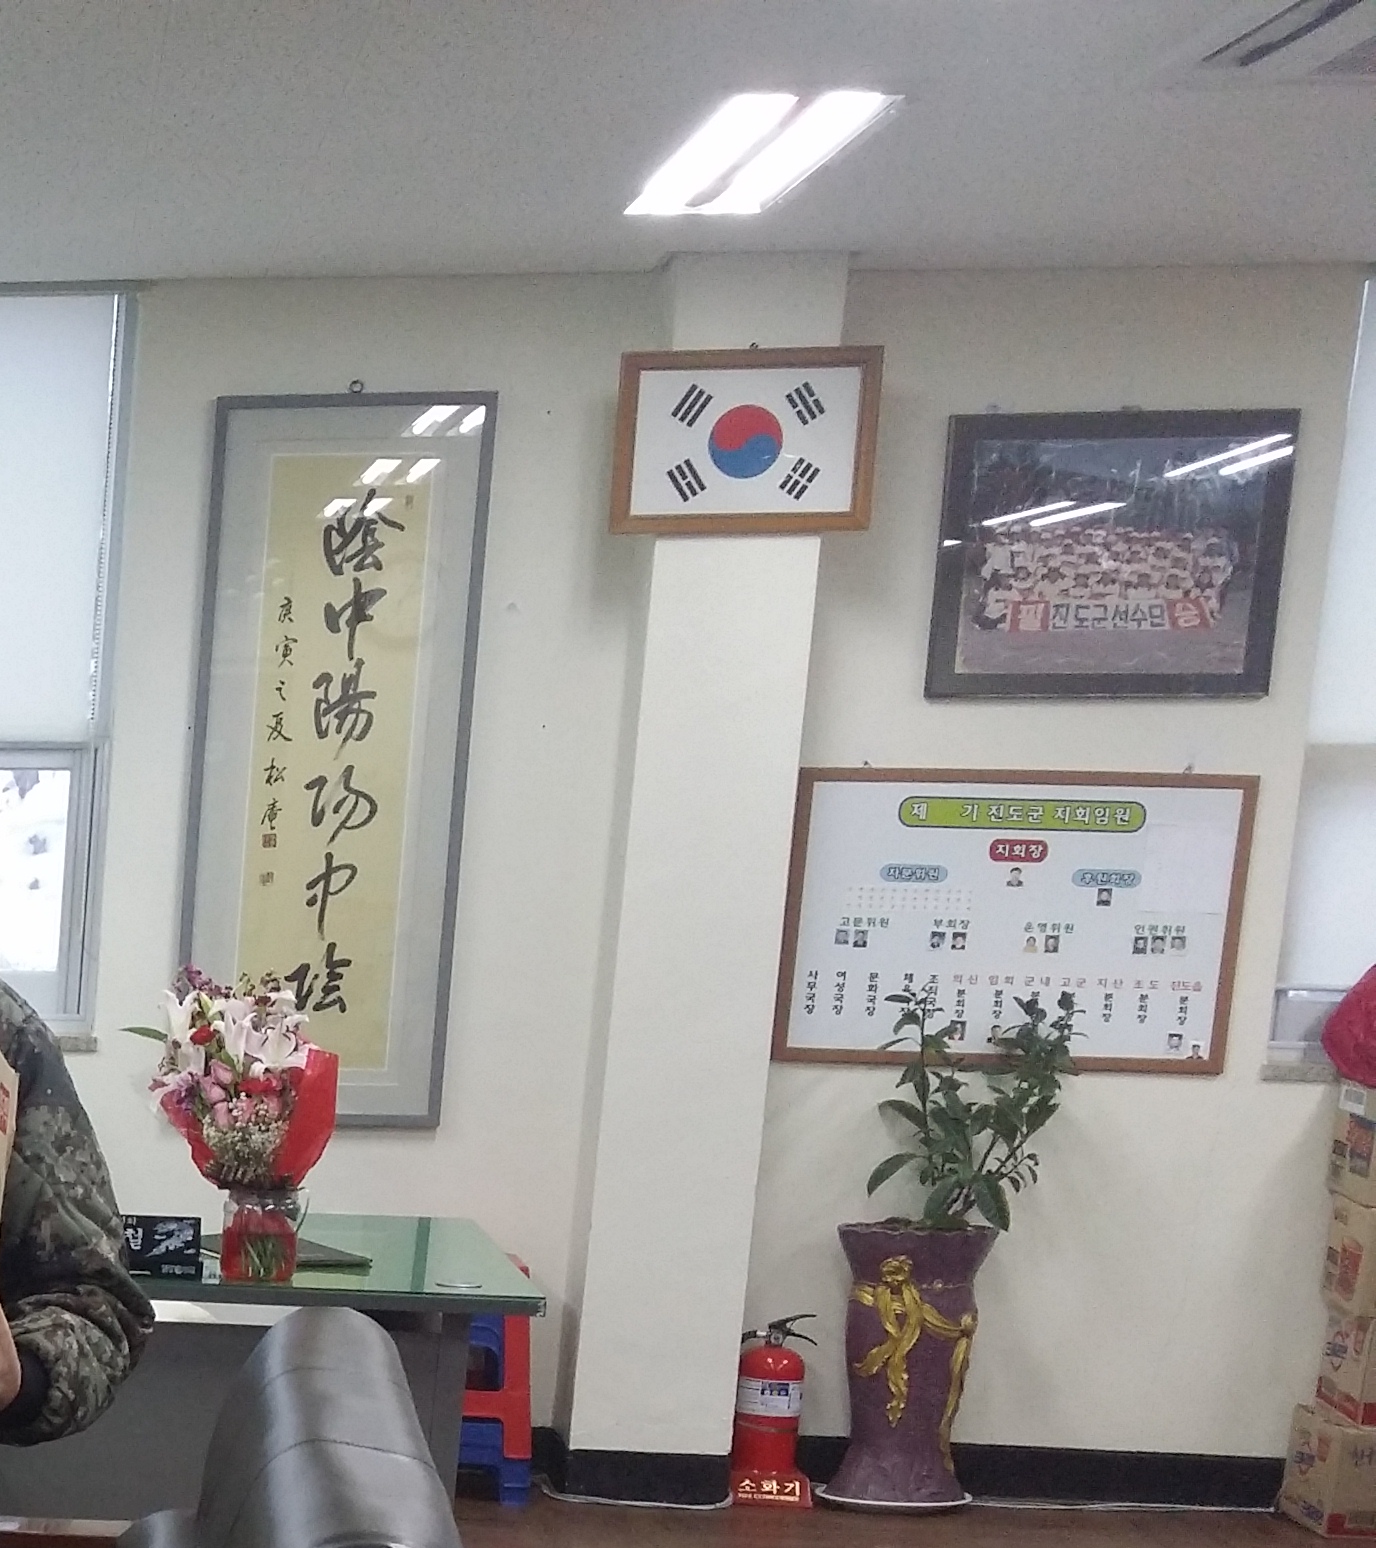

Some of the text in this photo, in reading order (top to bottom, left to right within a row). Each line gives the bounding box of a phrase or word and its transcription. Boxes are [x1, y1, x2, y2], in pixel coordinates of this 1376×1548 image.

[911, 802, 1132, 825] 제 기 진도군 지회임원
[995, 843, 1044, 859] 지회장
[738, 1479, 801, 1496] 소화기
